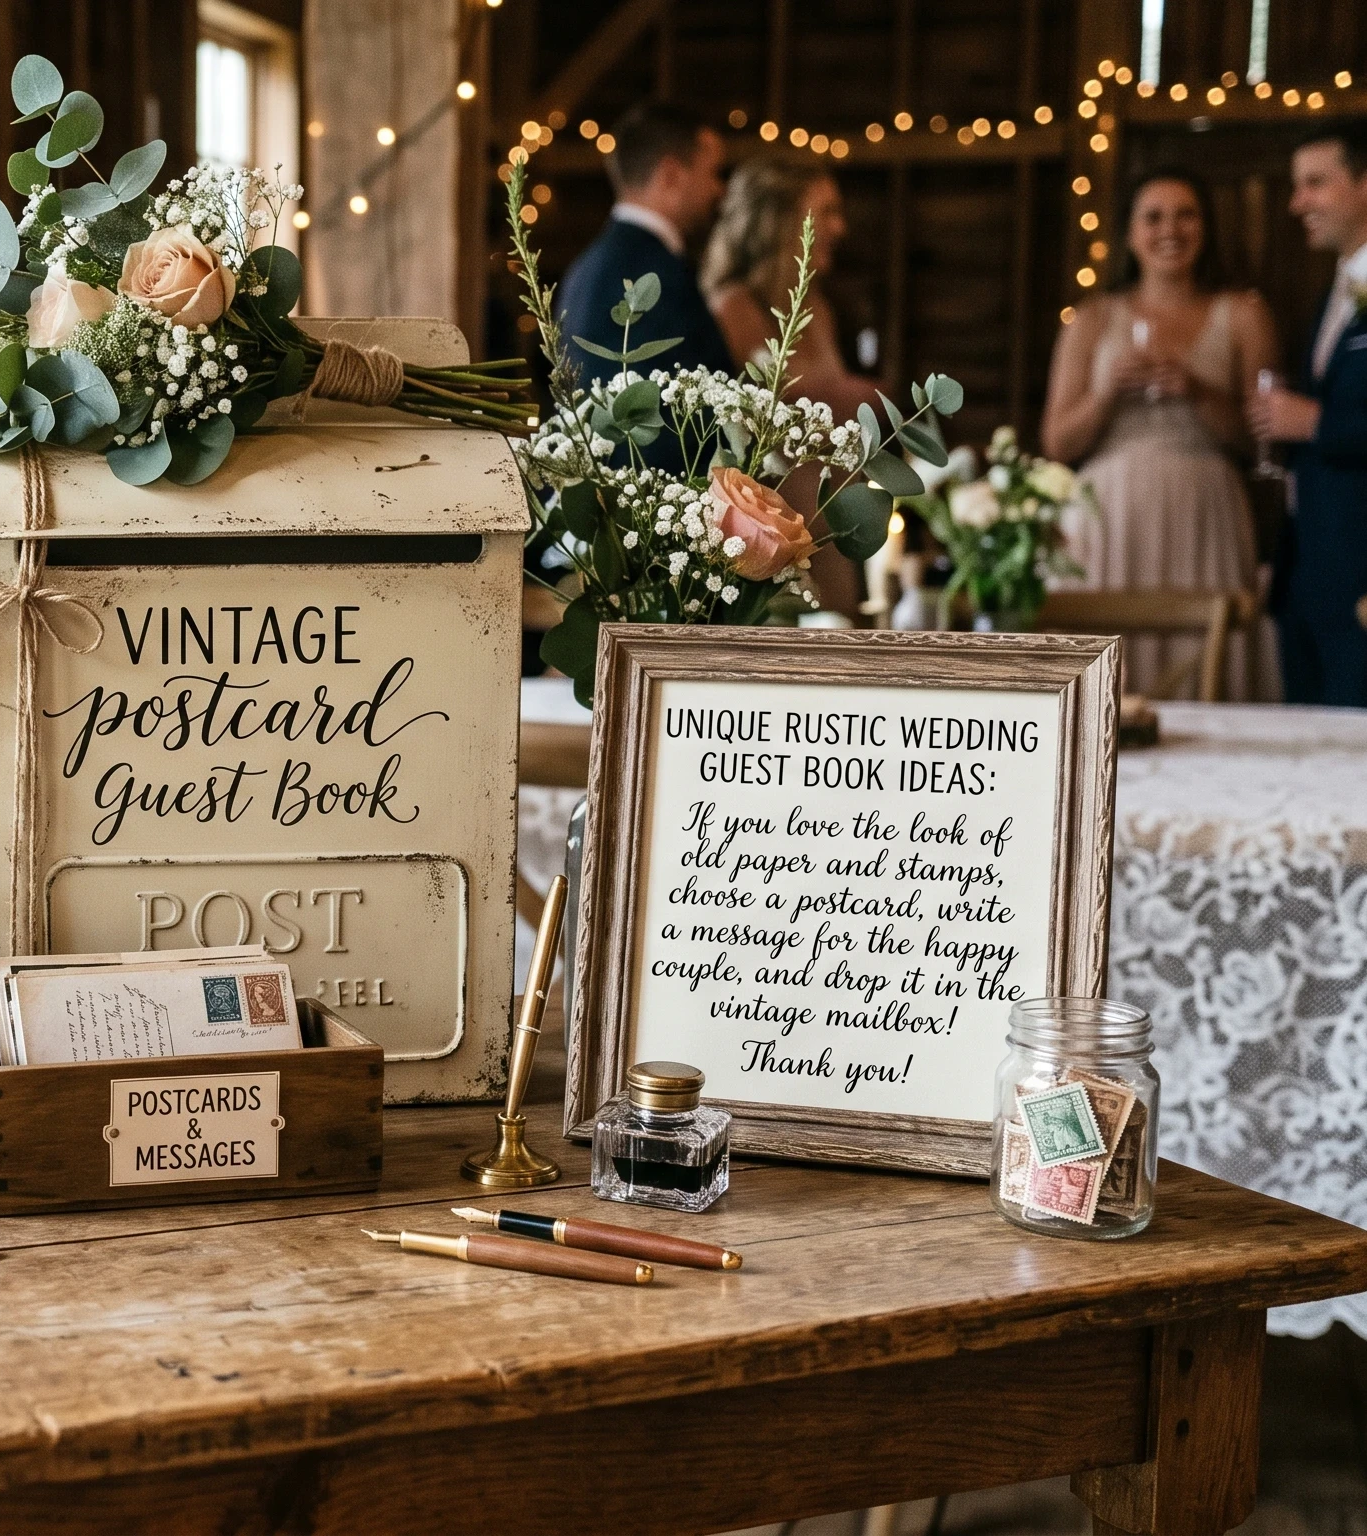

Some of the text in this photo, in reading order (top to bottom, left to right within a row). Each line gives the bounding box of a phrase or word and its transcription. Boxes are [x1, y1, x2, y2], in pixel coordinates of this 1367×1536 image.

[116, 606, 361, 665] VINTAGE
[42, 657, 451, 779] postcard
[666, 708, 1039, 753] UNIQUE RUSTIC WEDDING
[91, 753, 420, 846] Guest Book
[699, 751, 996, 796] GUEST BOOK IDEAS:
[681, 800, 1013, 858] If you love the look of
[680, 837, 1004, 897] old paper and stamps,
[136, 887, 364, 953] POST
[668, 874, 1016, 924] choose a postcard, write
[661, 920, 1020, 974] a message for the happy
[651, 951, 1026, 1003] couple, and drop it in the
[709, 995, 960, 1037] vintage mailbox!
[740, 1039, 915, 1094] Thank you!
[128, 1085, 261, 1117] POSTCARDS
[187, 1117, 202, 1140] &
[136, 1139, 256, 1172] MESSAGES
